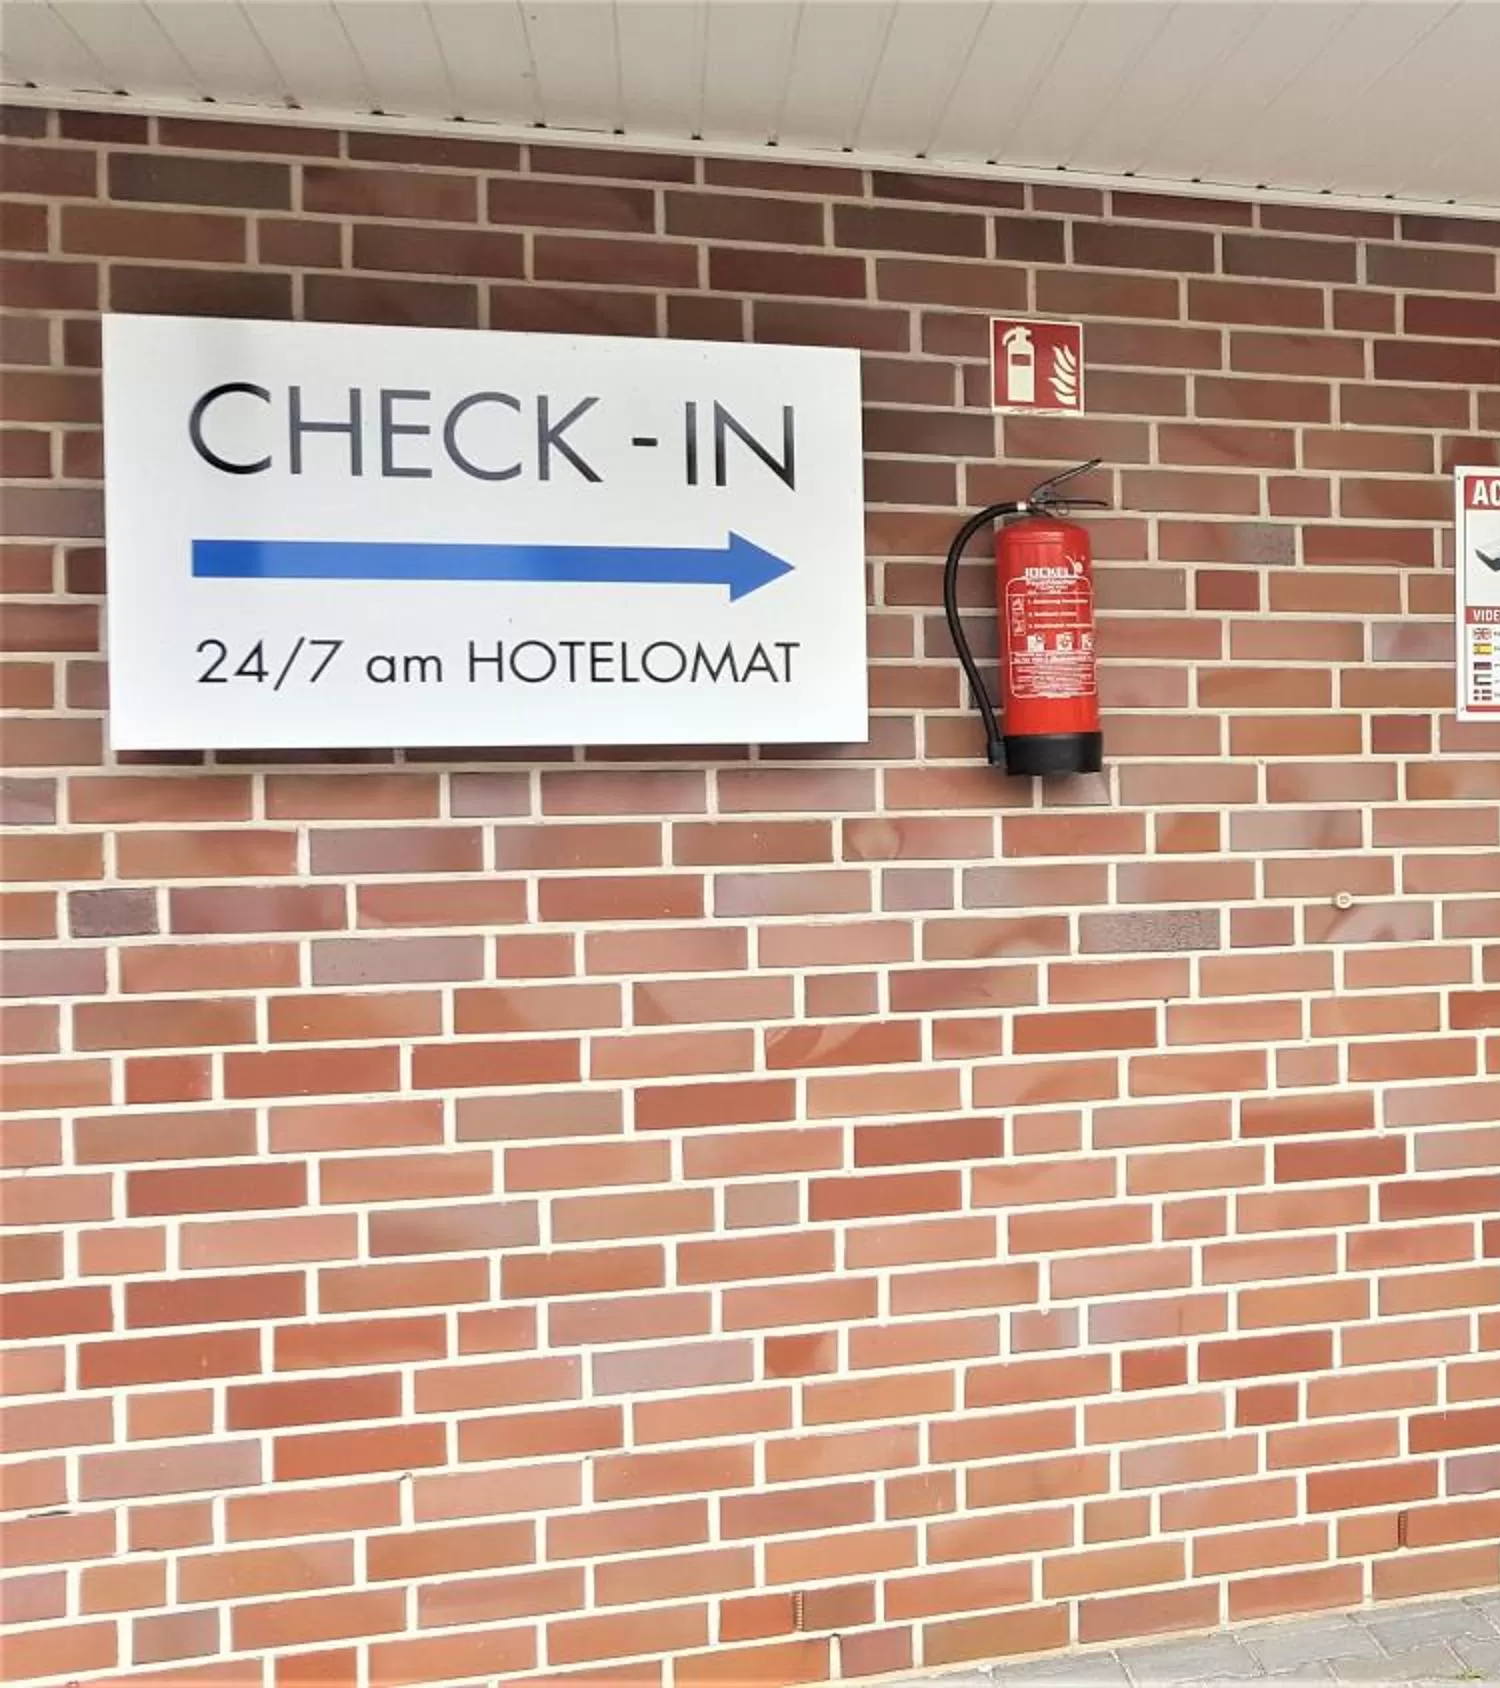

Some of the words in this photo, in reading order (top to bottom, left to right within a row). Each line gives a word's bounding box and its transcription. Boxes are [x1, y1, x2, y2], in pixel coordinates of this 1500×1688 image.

[195, 636, 343, 691] 24/7
[366, 655, 443, 684] am
[469, 640, 801, 684] HOTELOMAT
